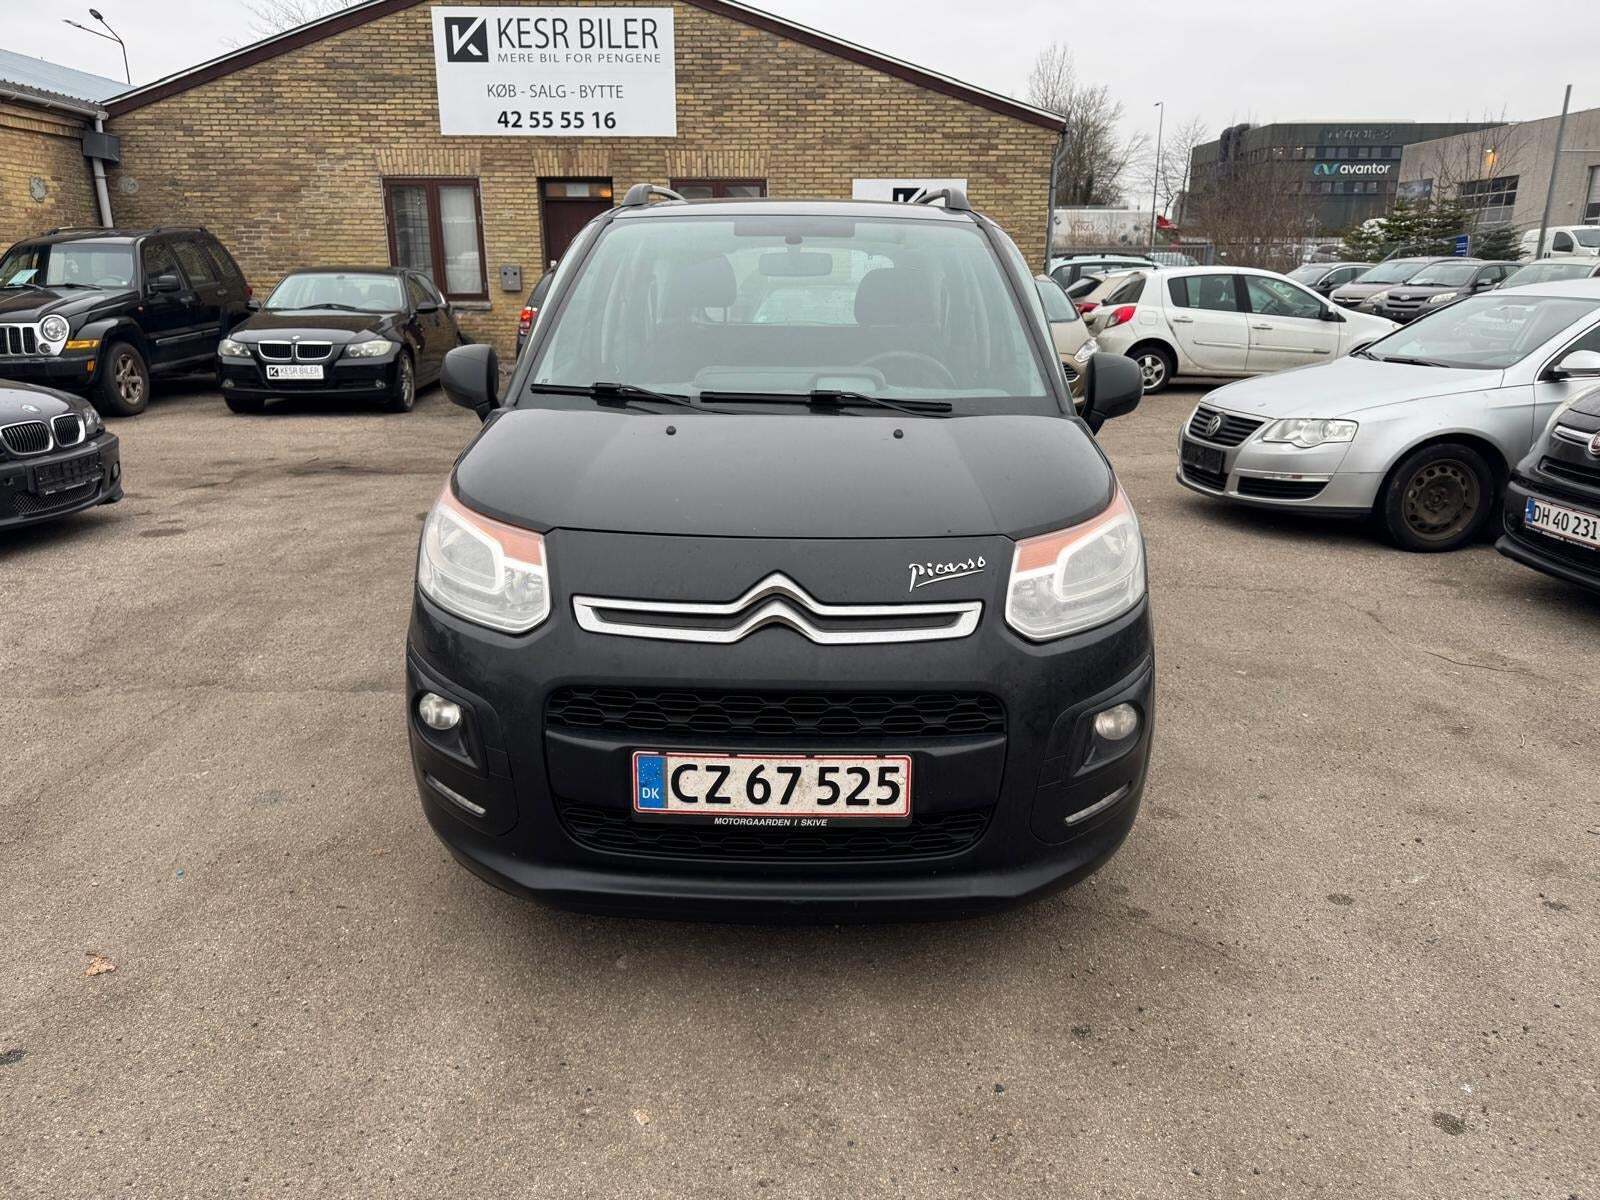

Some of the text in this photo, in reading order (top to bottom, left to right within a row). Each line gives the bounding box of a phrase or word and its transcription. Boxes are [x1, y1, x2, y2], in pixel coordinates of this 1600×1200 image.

[497, 18, 659, 49] KESR BILER
[497, 53, 661, 63] MERE BIL FOR PENGENE
[487, 83, 517, 98] KØB
[529, 84, 566, 98] SALG
[579, 84, 624, 99] BYTTE
[497, 110, 617, 129] 42 55 55 16
[1340, 163, 1391, 175] avantor
[1533, 505, 1597, 540] DH 40 231
[670, 763, 901, 806] CZ 67 525
[642, 787, 660, 800] DK
[714, 817, 790, 827] MOTORGAARDEN
[800, 819, 828, 827] SKIVE
